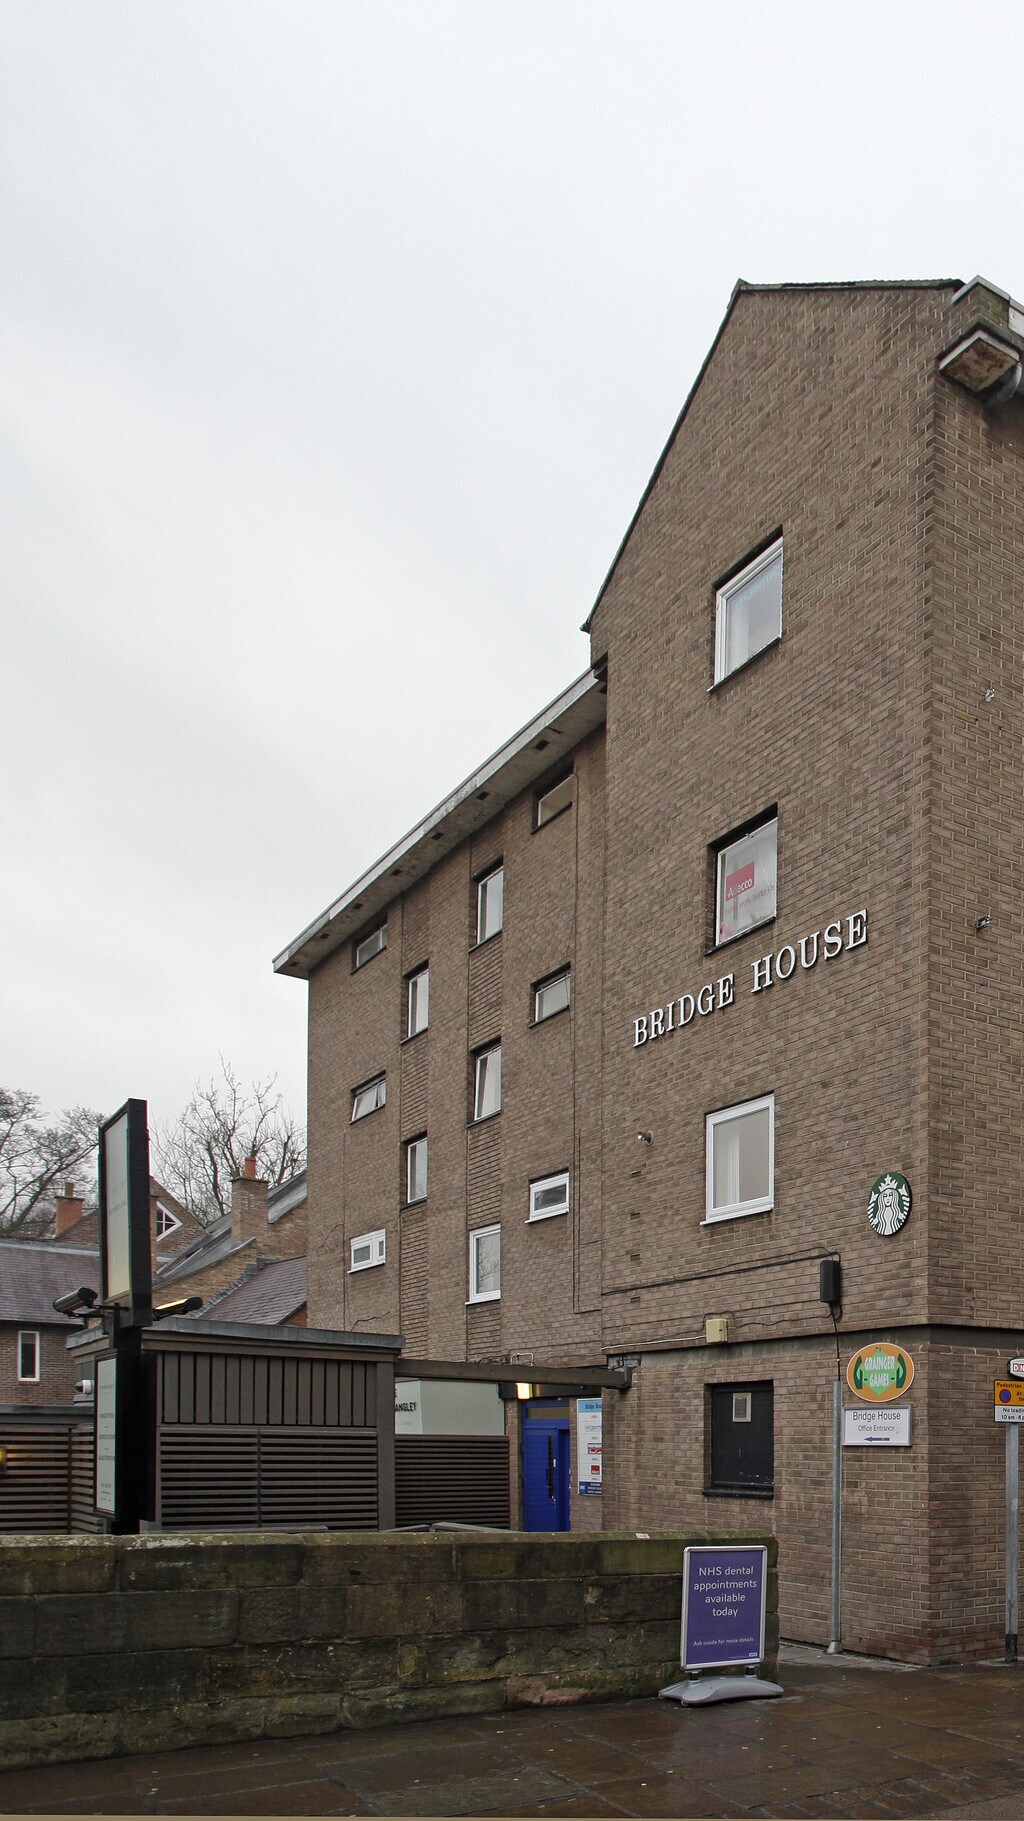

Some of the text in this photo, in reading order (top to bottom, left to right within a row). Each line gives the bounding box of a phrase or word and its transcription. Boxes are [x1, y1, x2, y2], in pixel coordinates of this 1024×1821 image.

[633, 908, 868, 1048] BRIDGE HOUSE
[864, 1355, 896, 1371] GRAINGER
[869, 1373, 890, 1388] GAMES
[395, 1401, 417, 1412] ANGLEY
[852, 1411, 901, 1422] Bridge House
[858, 1424, 873, 1432] Office
[698, 1566, 754, 1576] NHS dental
[693, 1580, 757, 1592] appointments
[705, 1594, 746, 1604] available
[712, 1607, 739, 1617] today
